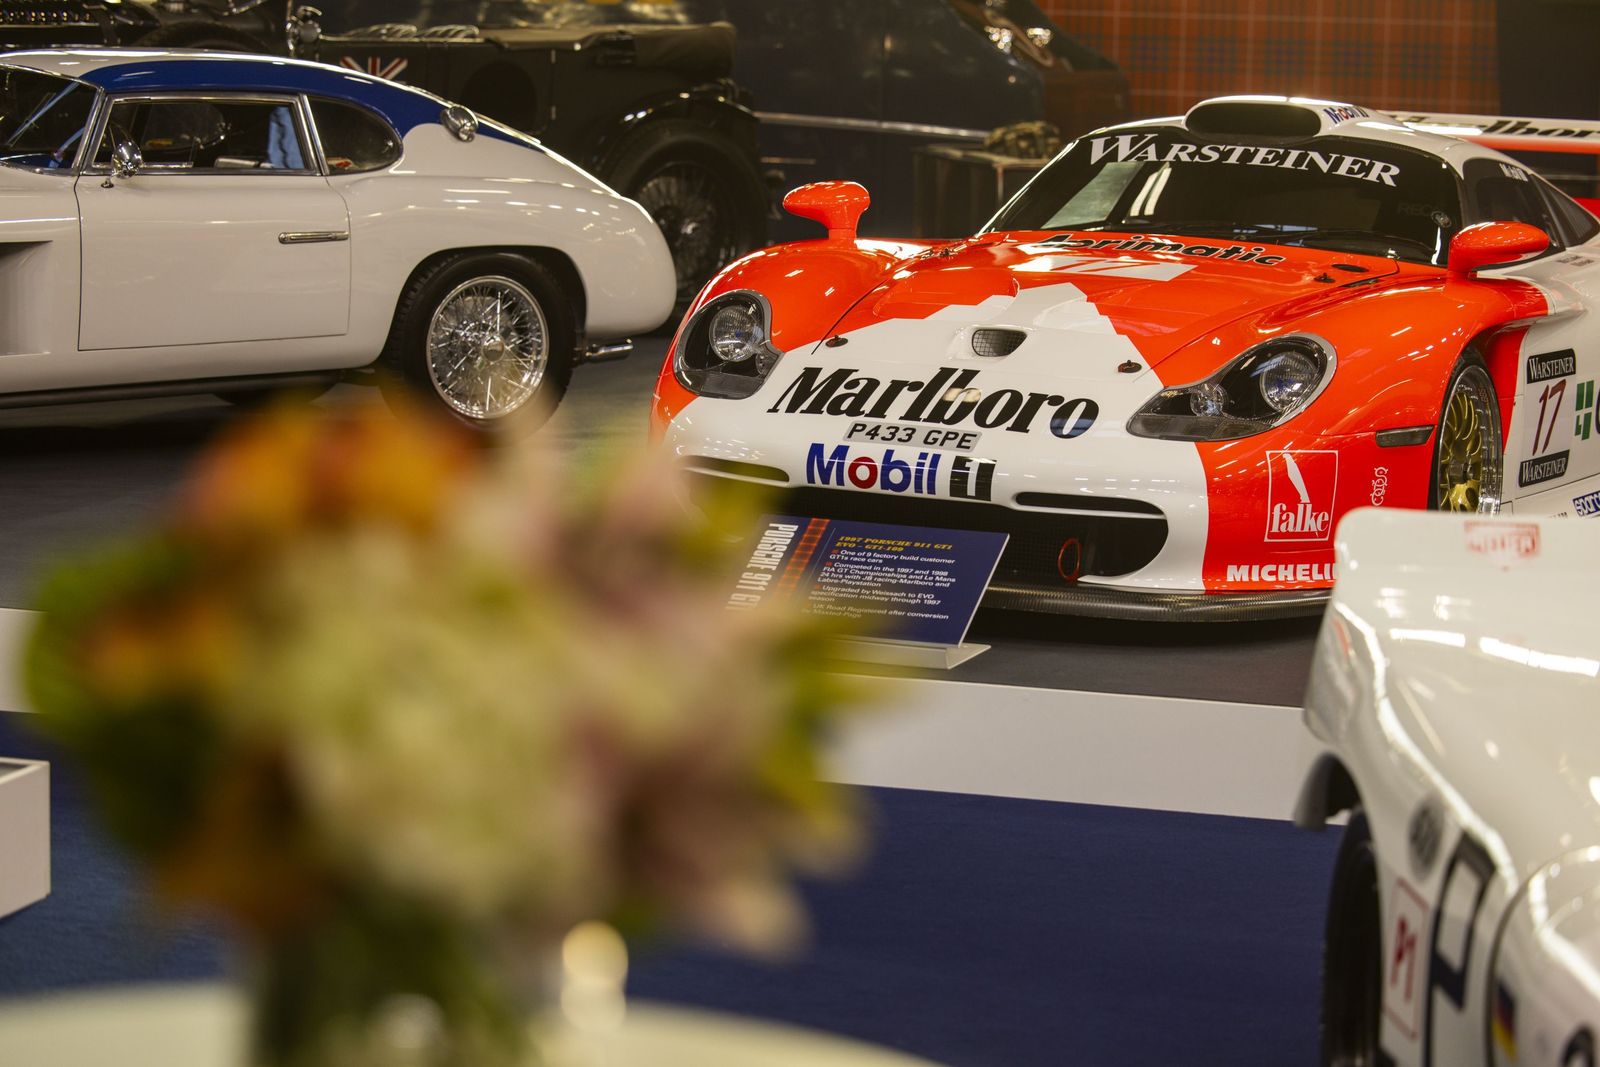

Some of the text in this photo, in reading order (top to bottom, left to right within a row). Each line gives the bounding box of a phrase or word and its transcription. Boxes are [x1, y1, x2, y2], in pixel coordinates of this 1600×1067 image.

[1089, 133, 1401, 188] WARSTEINER
[1528, 355, 1575, 380] WARSTEINER
[766, 366, 1100, 440] Marlboro
[1531, 378, 1567, 456] 17
[846, 422, 978, 450] P433 GPE
[805, 442, 942, 496] Mobil
[1520, 457, 1567, 484] WARSTEINER
[1270, 502, 1330, 538] falke
[746, 522, 799, 571] PORSCHE
[835, 541, 856, 549] EVO
[863, 537, 912, 547] PORSCHE
[834, 561, 873, 571] Competed
[873, 553, 899, 561] factory
[735, 572, 773, 591] 911
[849, 568, 908, 579] Championships
[1226, 563, 1337, 582] MICHELI
[822, 584, 860, 595] Upgraded
[861, 587, 871, 595] by
[923, 598, 941, 606] 1997
[907, 612, 950, 620] conversion
